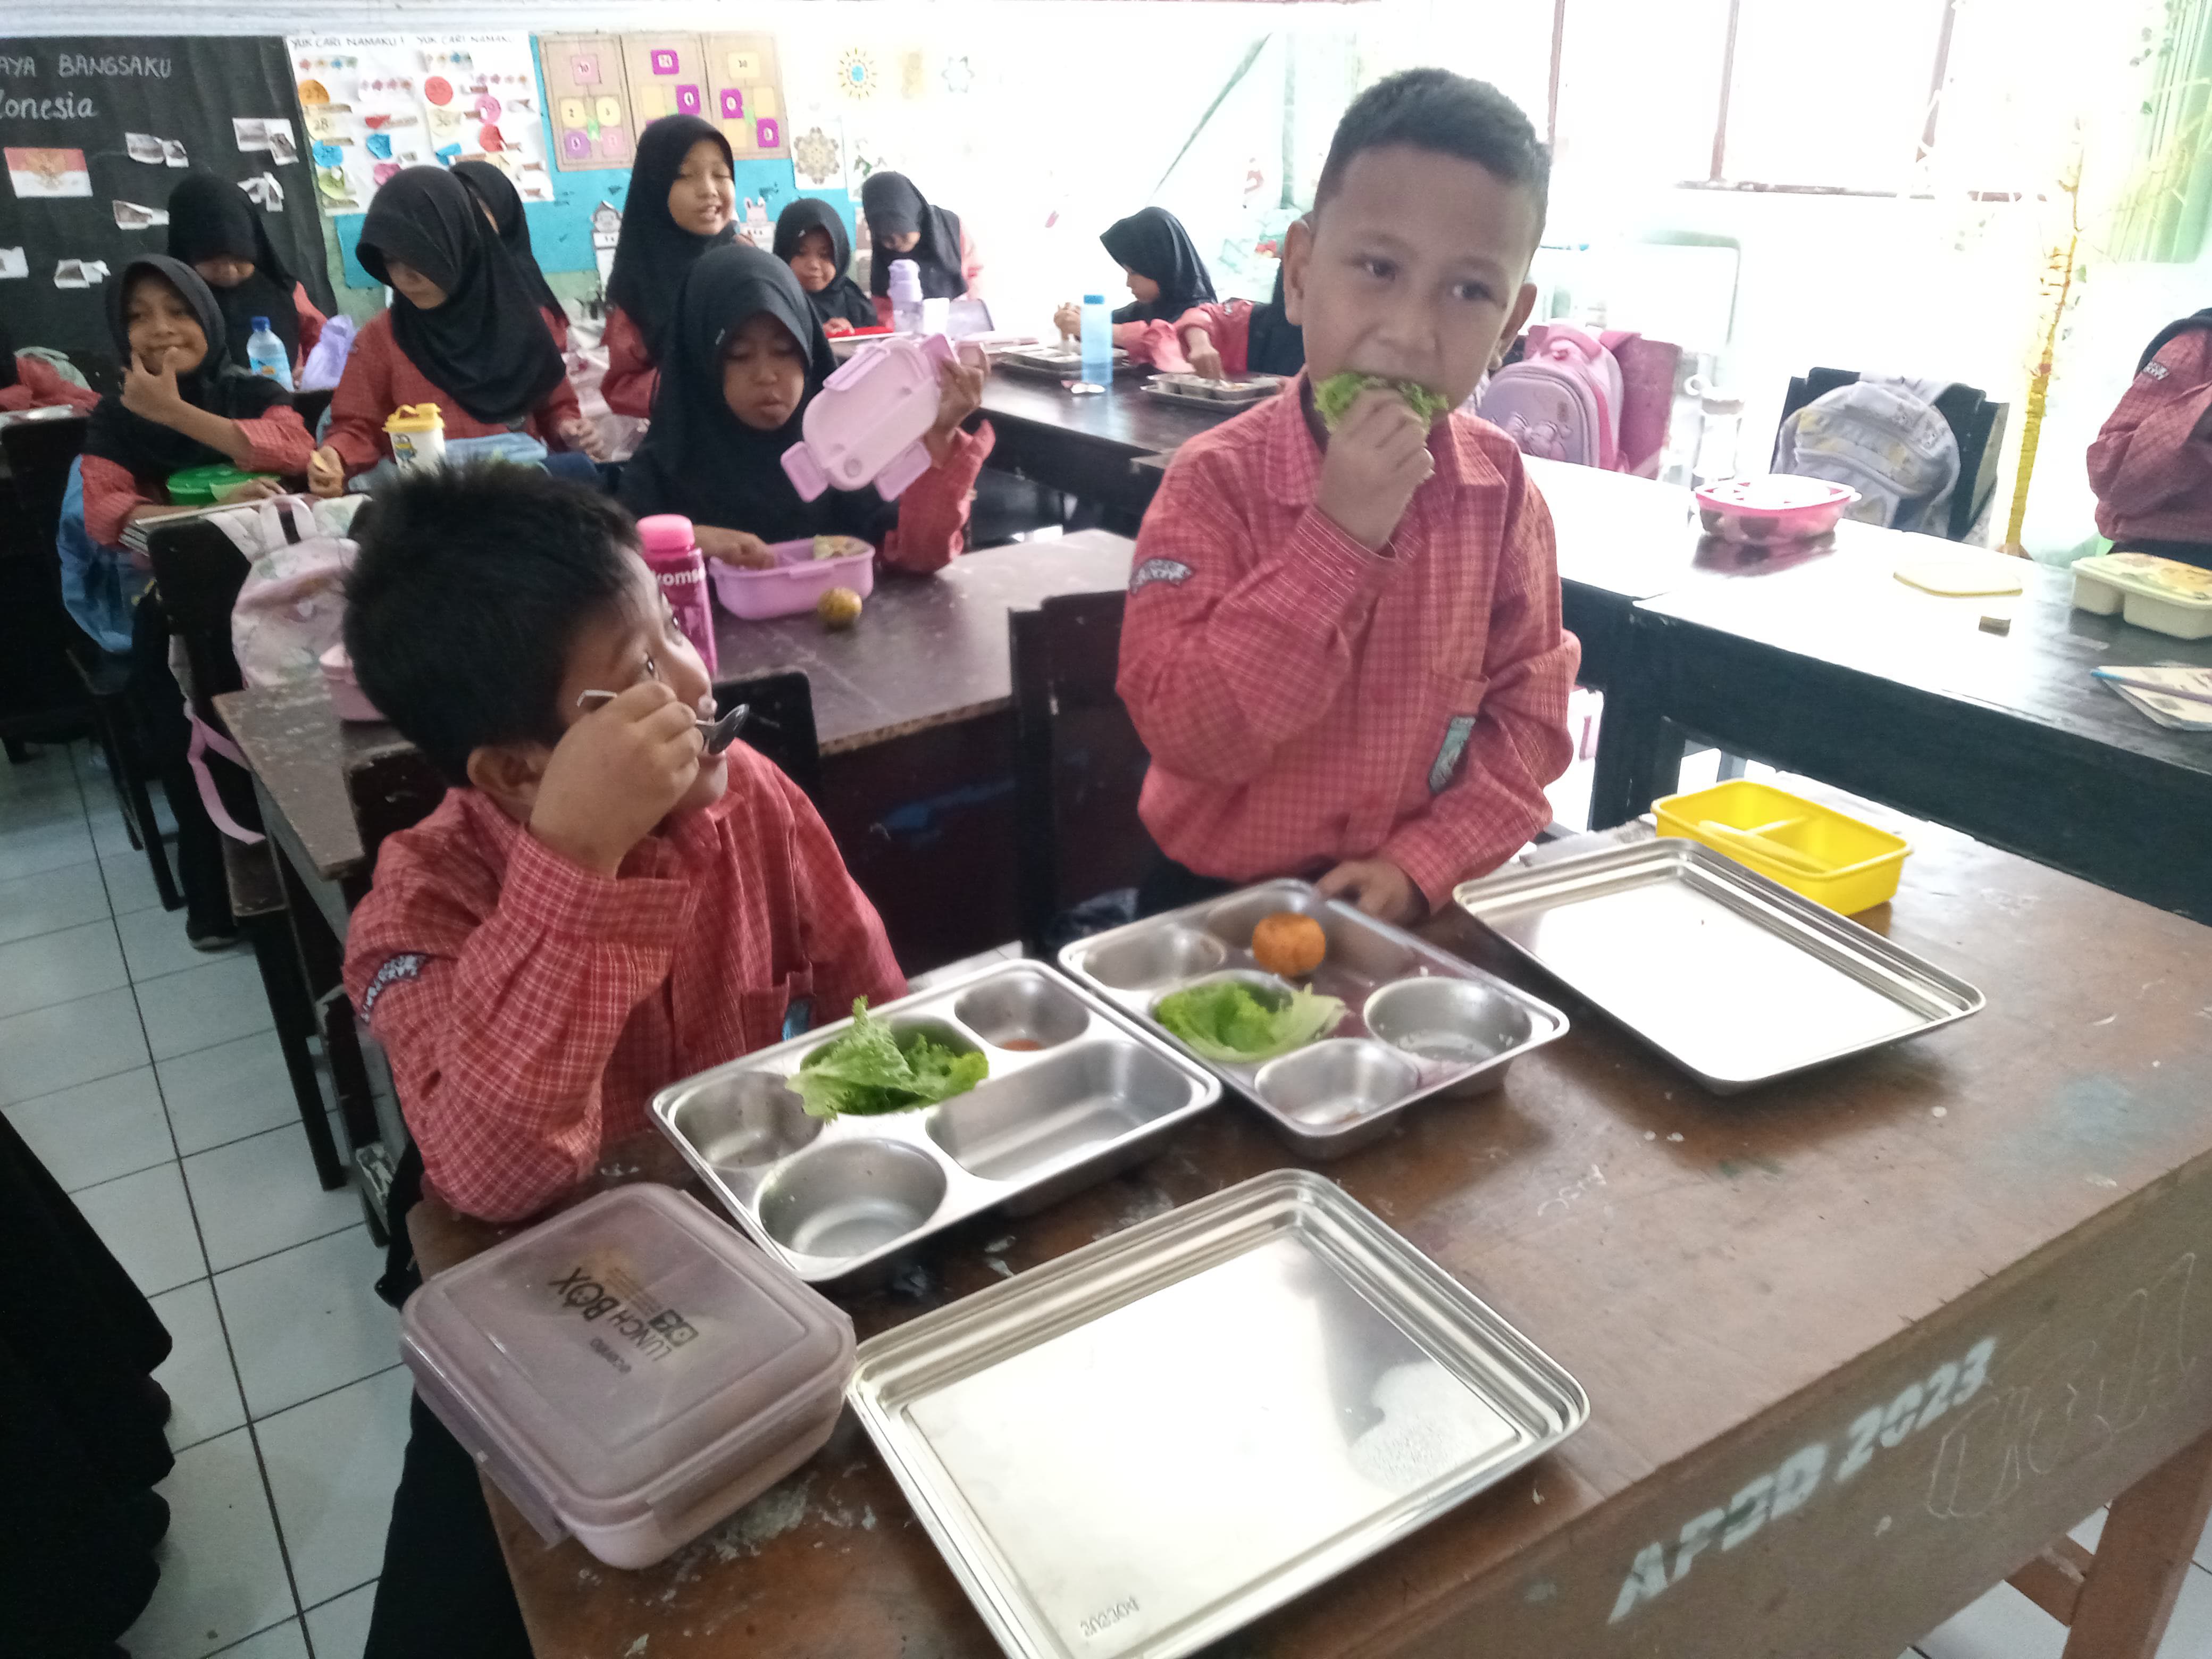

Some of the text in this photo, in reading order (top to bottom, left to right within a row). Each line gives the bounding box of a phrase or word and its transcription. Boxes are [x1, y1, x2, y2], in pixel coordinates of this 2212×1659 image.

[58, 53, 172, 79] BANGSAKU
[548, 1267, 620, 1322] BOX
[608, 1309, 673, 1362] LUNCH
[1834, 1336, 1997, 1484] 2023
